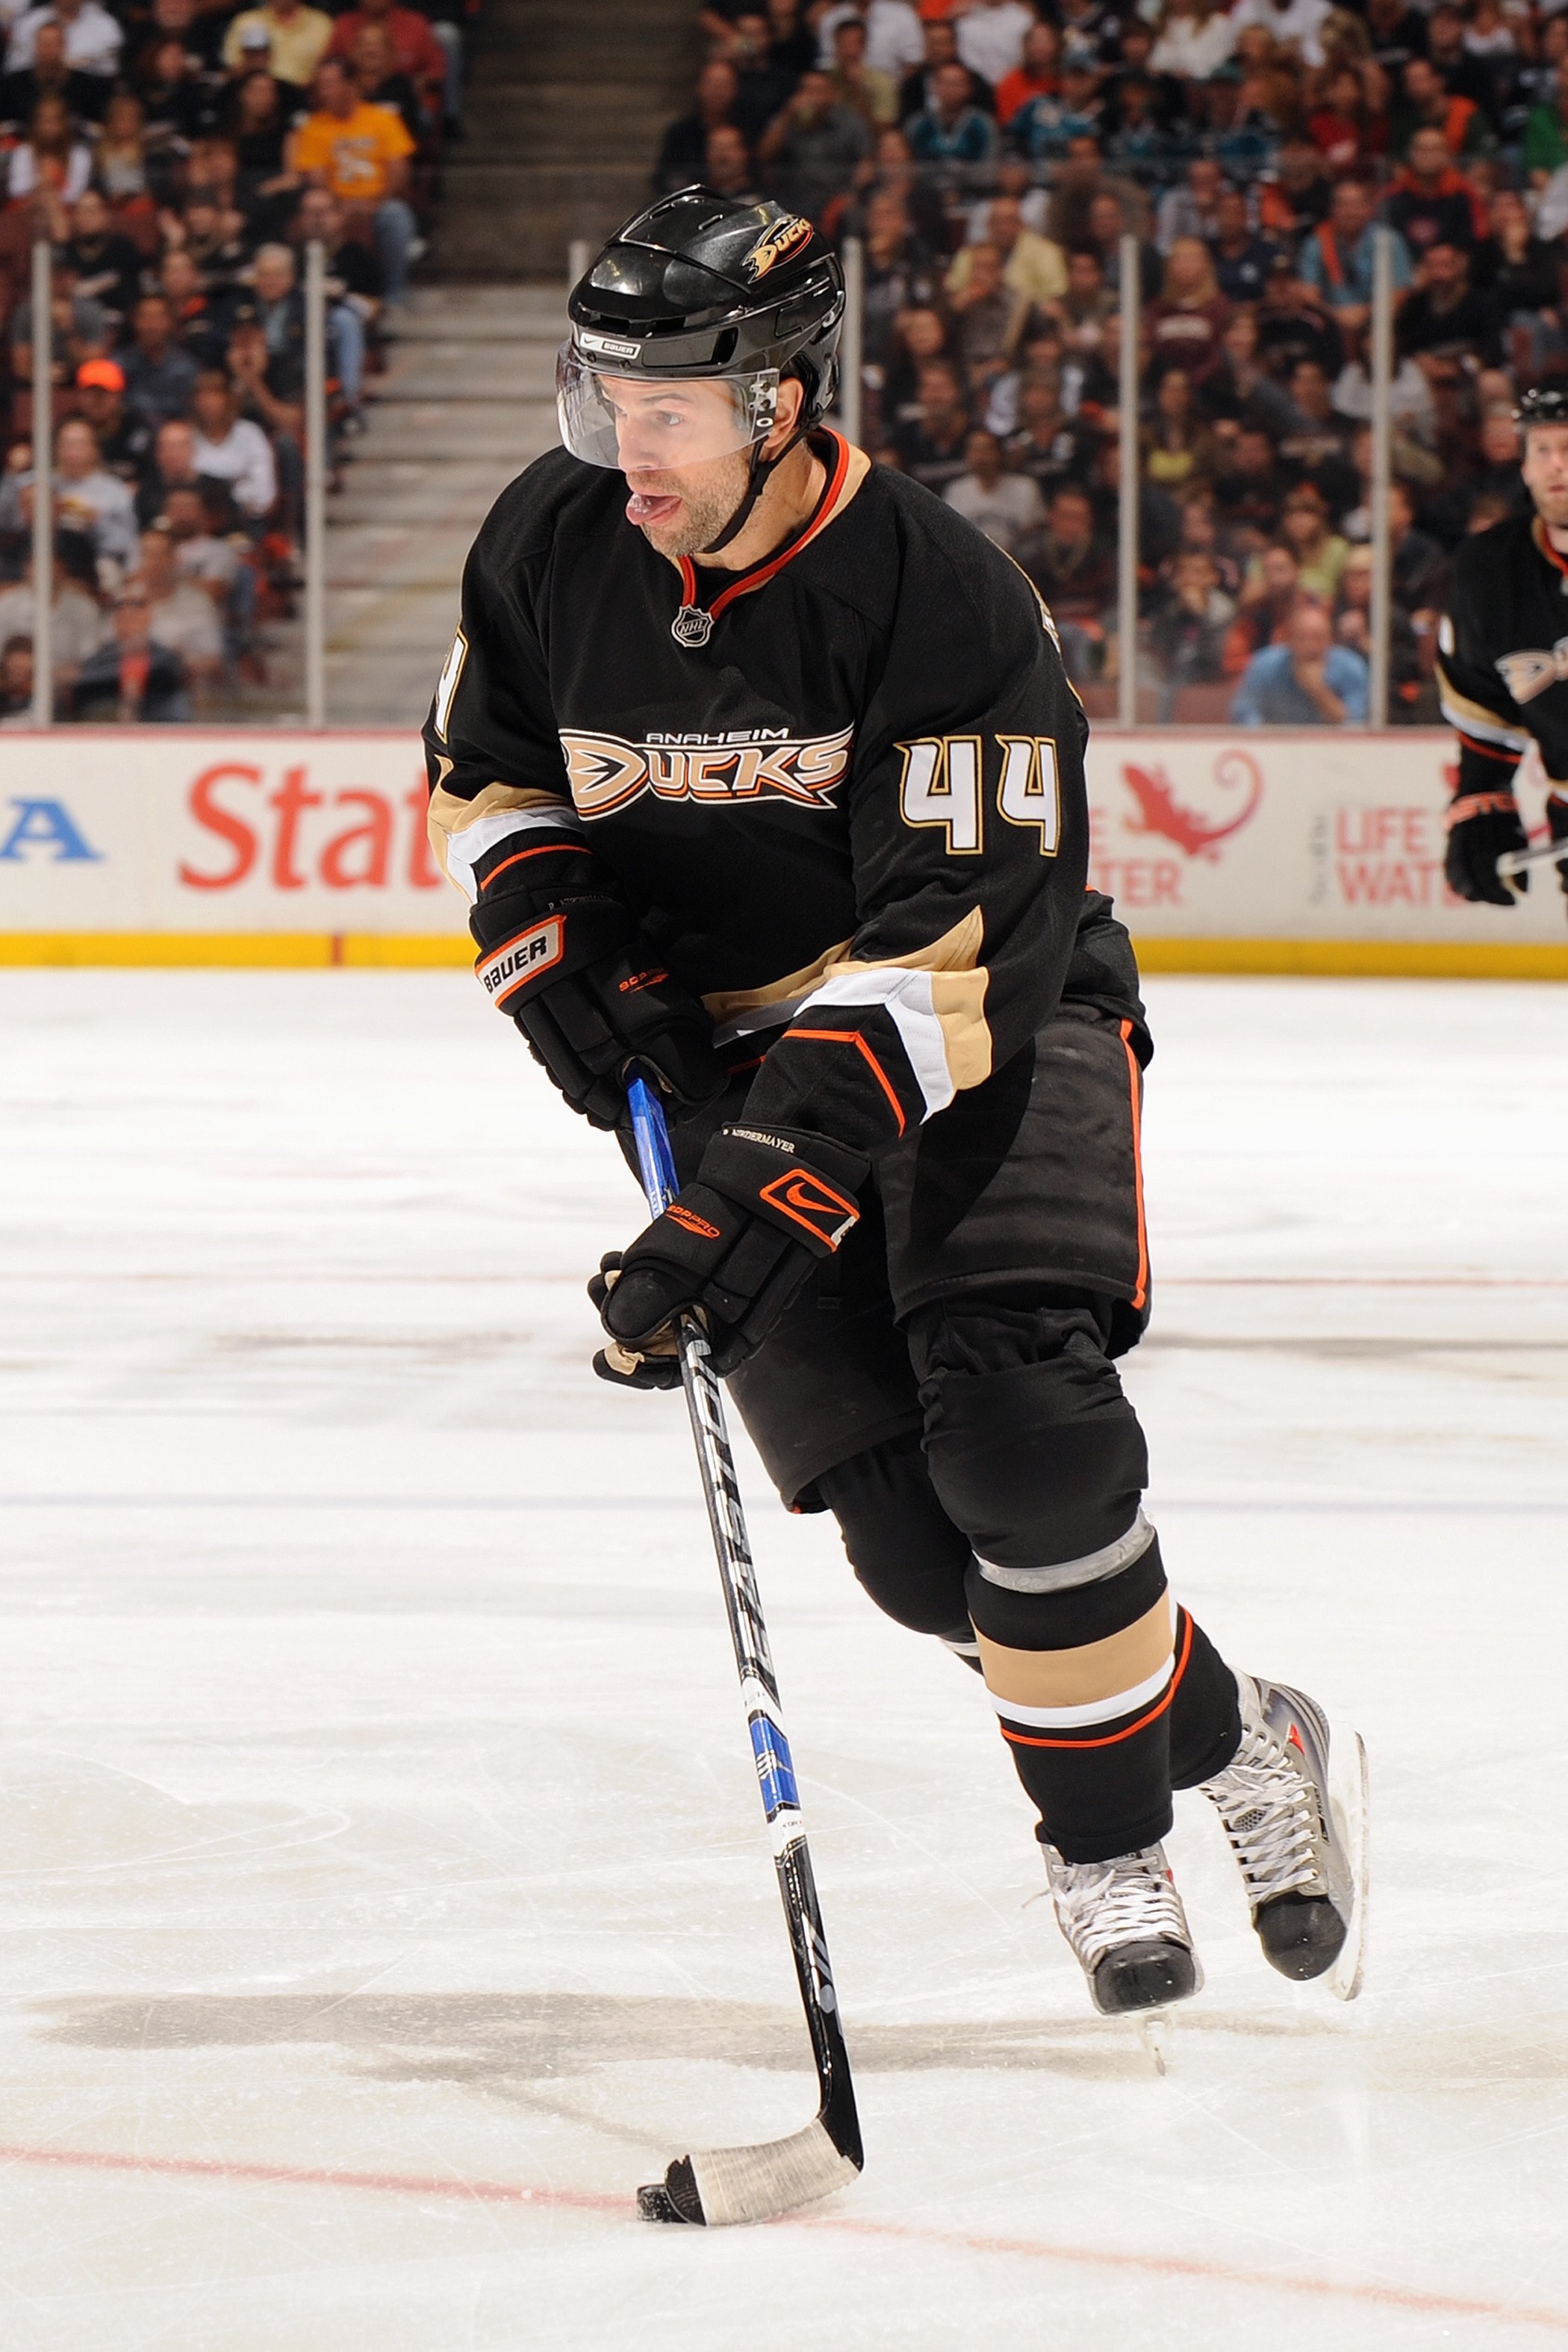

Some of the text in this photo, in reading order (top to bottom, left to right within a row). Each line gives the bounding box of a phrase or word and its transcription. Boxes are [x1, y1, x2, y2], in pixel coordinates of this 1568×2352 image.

[603, 342, 635, 355] BAUER
[679, 620, 705, 634] NHL
[646, 727, 789, 745] ANAHEIM
[561, 722, 854, 815] DUCKS
[893, 733, 1058, 857] 44
[1336, 807, 1427, 855] LIFE
[483, 935, 547, 994] BAUER
[686, 1339, 777, 1675] EASTON
